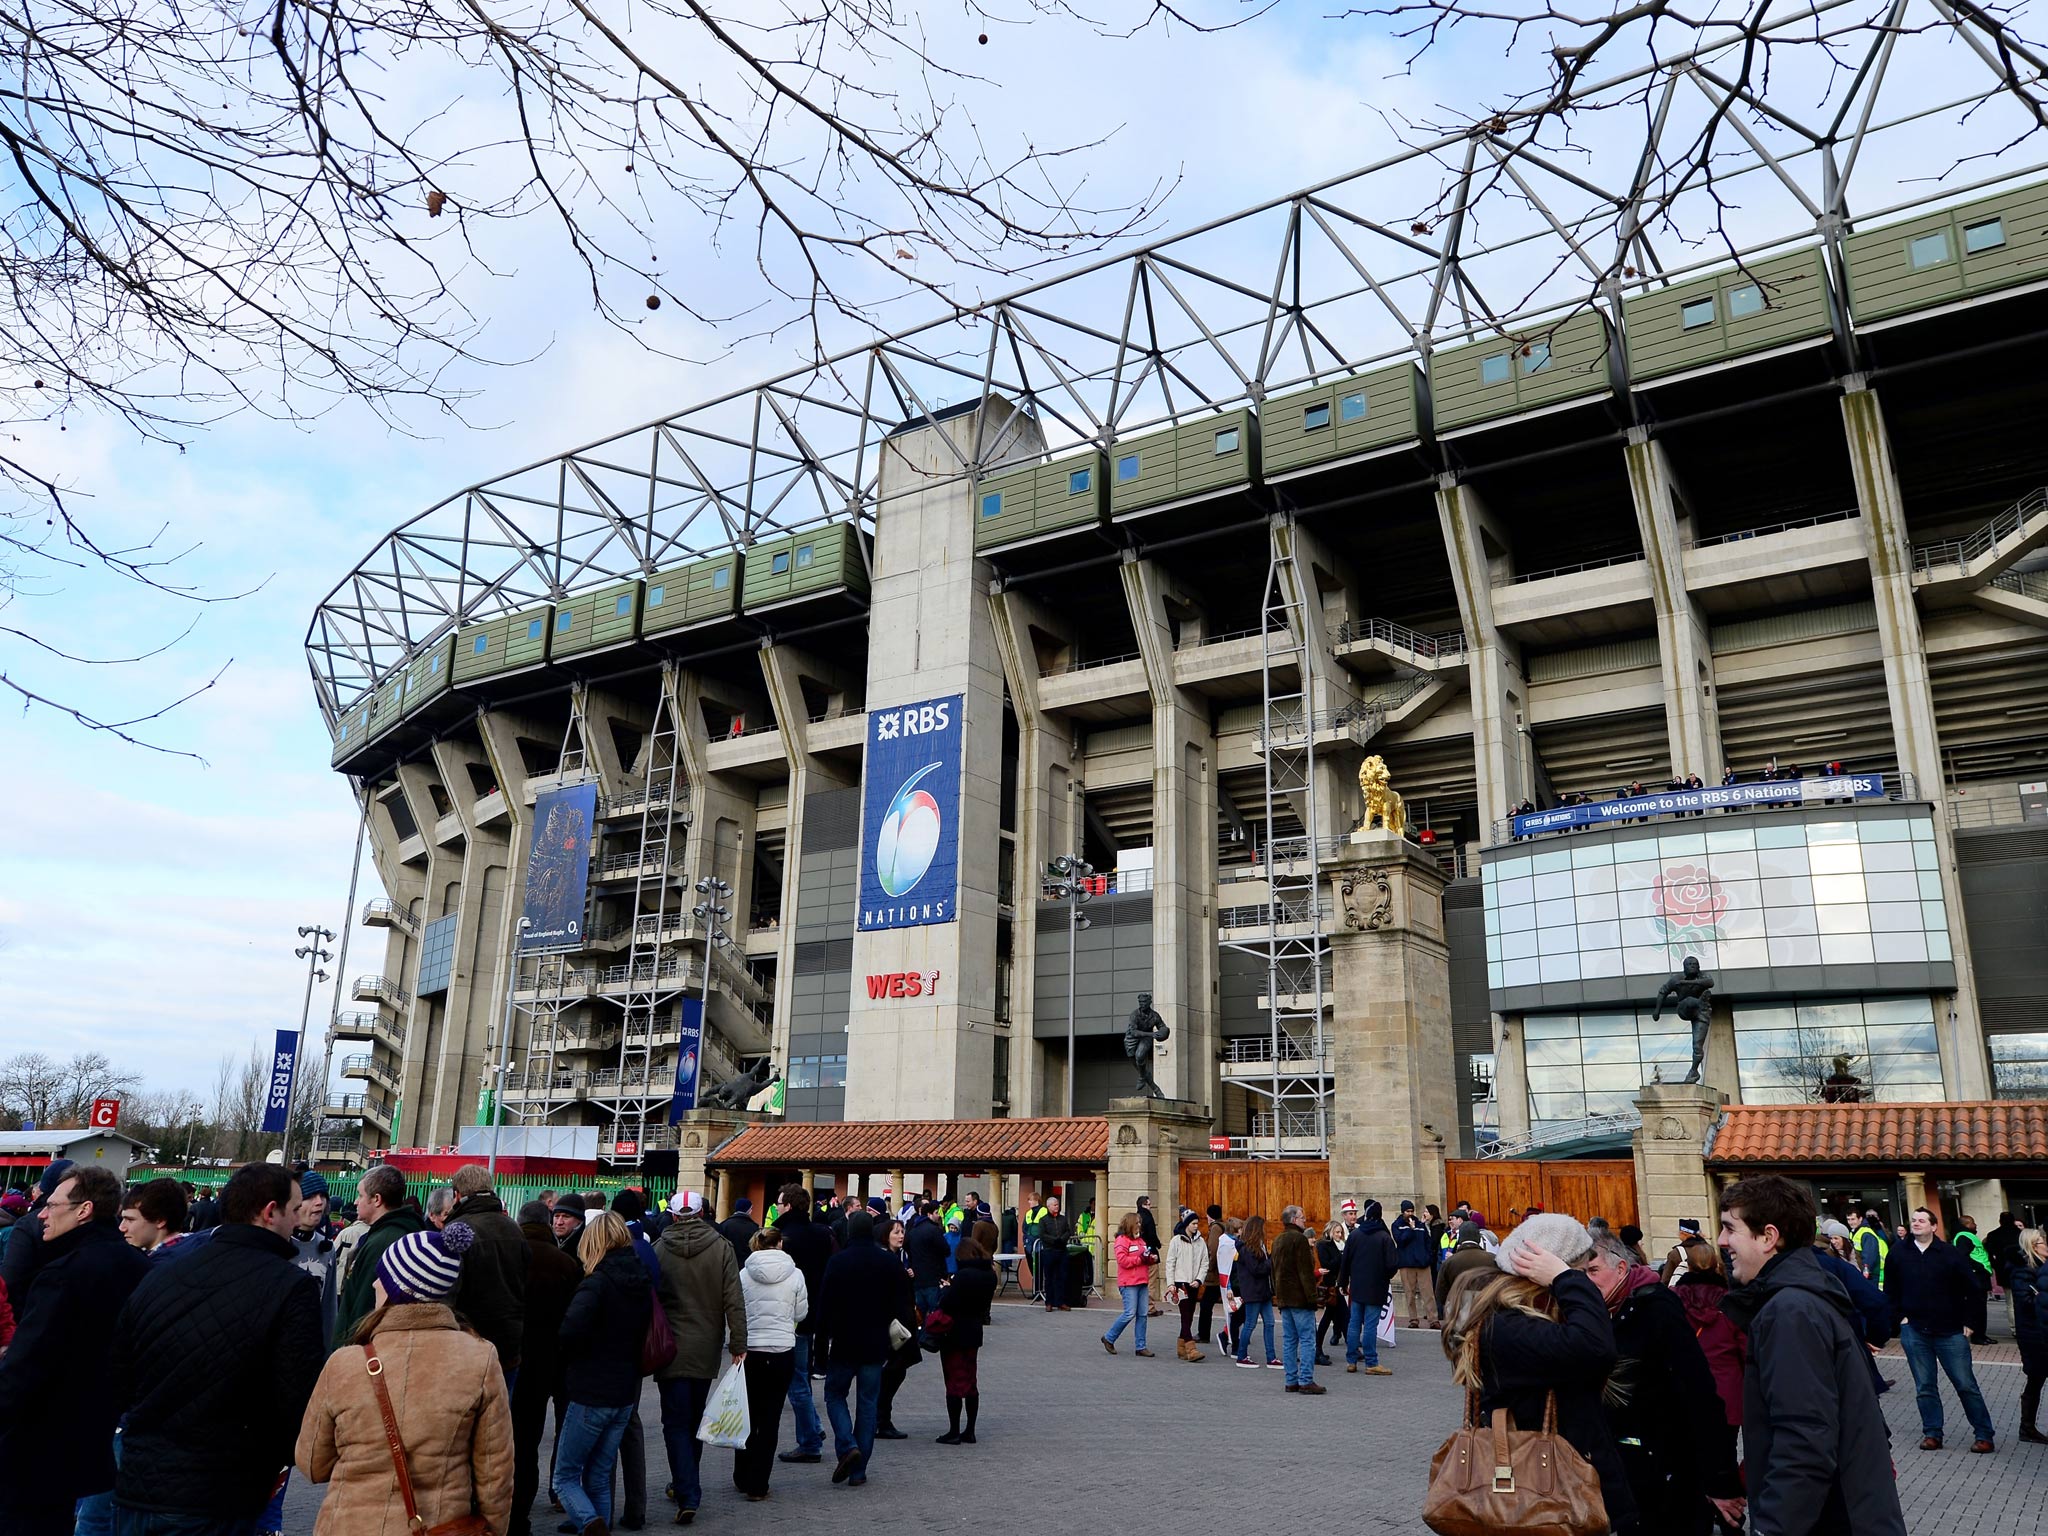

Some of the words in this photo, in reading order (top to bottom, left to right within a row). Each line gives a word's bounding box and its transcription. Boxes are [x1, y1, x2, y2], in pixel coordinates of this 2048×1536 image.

[903, 703, 949, 737] RBS
[1843, 778, 1872, 792] RBS
[1600, 801, 1657, 817] Welcome
[1659, 797, 1673, 809] to
[1675, 793, 1699, 807] the
[1702, 790, 1729, 804] RBS
[1732, 790, 1741, 801] 6
[1744, 785, 1799, 800] Nations
[1531, 818, 1543, 827] RBS
[864, 903, 943, 925] NATIONS
[866, 969, 940, 1000] WEST
[688, 1027, 699, 1038] RBS
[270, 1072, 290, 1109] RBS
[97, 1107, 113, 1125] C
